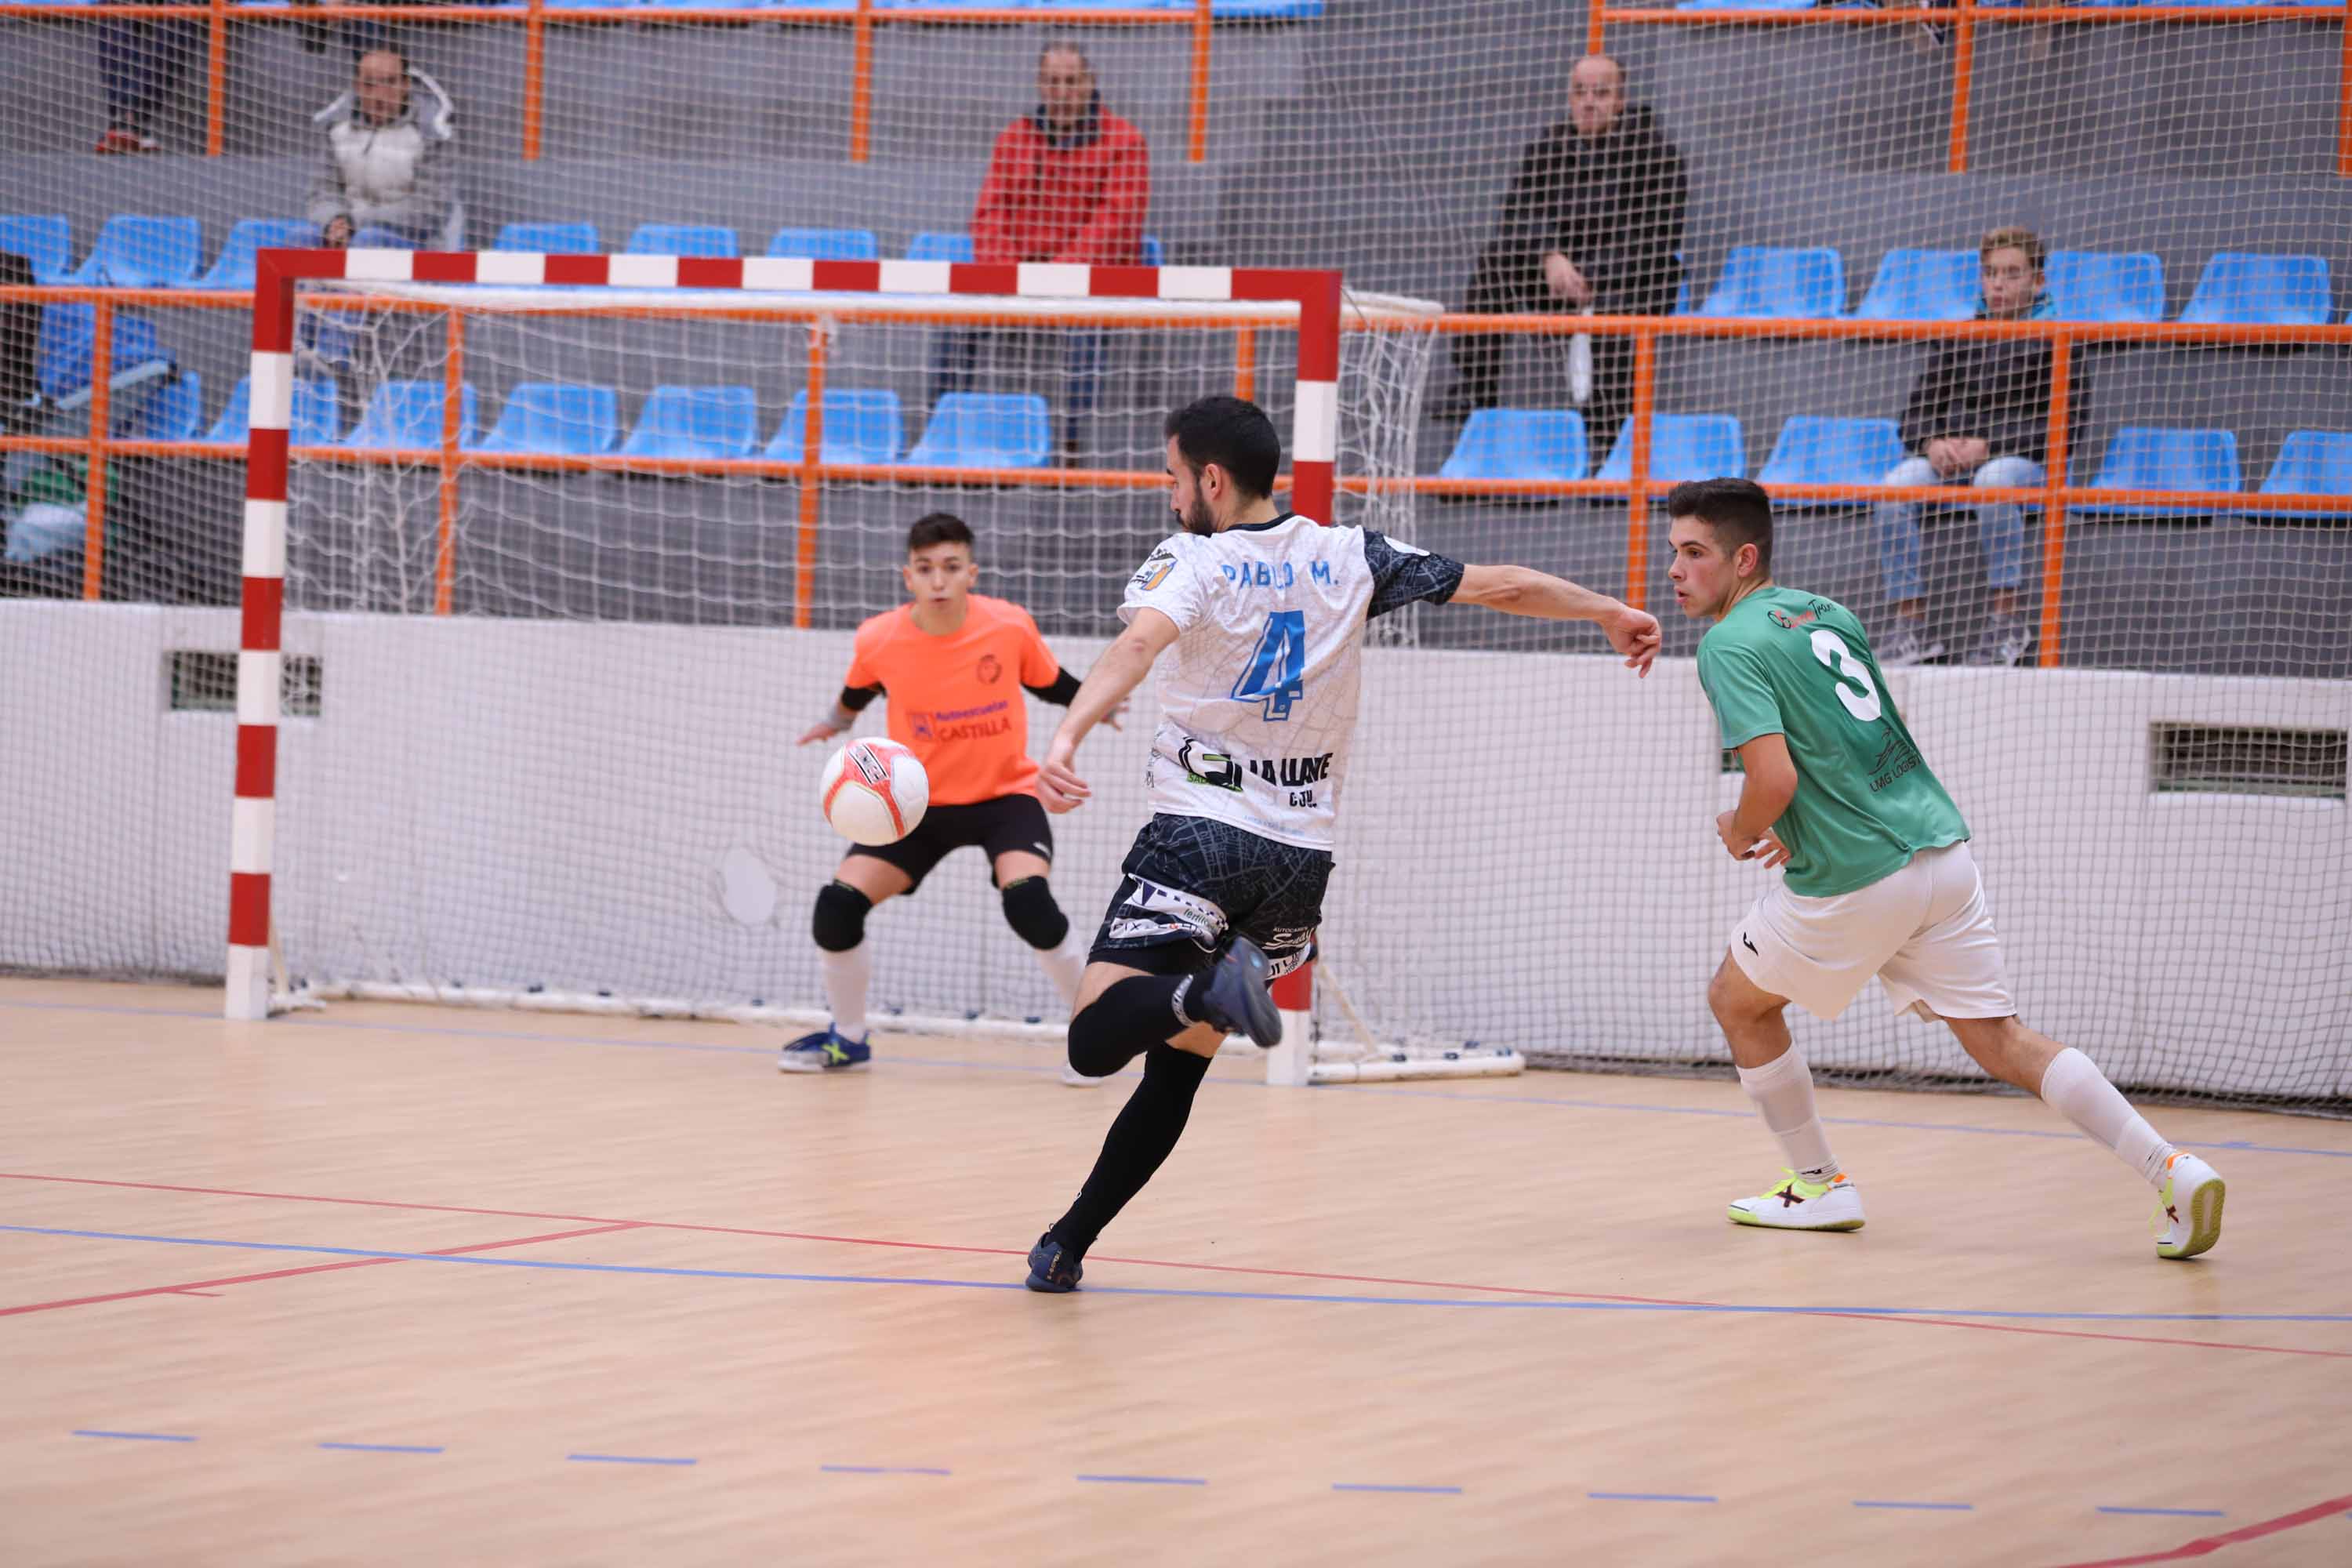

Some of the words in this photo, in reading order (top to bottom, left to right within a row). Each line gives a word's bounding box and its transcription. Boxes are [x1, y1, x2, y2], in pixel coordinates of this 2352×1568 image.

[1230, 609, 1305, 722] 4
[1809, 630, 1882, 721] 3
[938, 717, 1012, 742] CASTILLA
